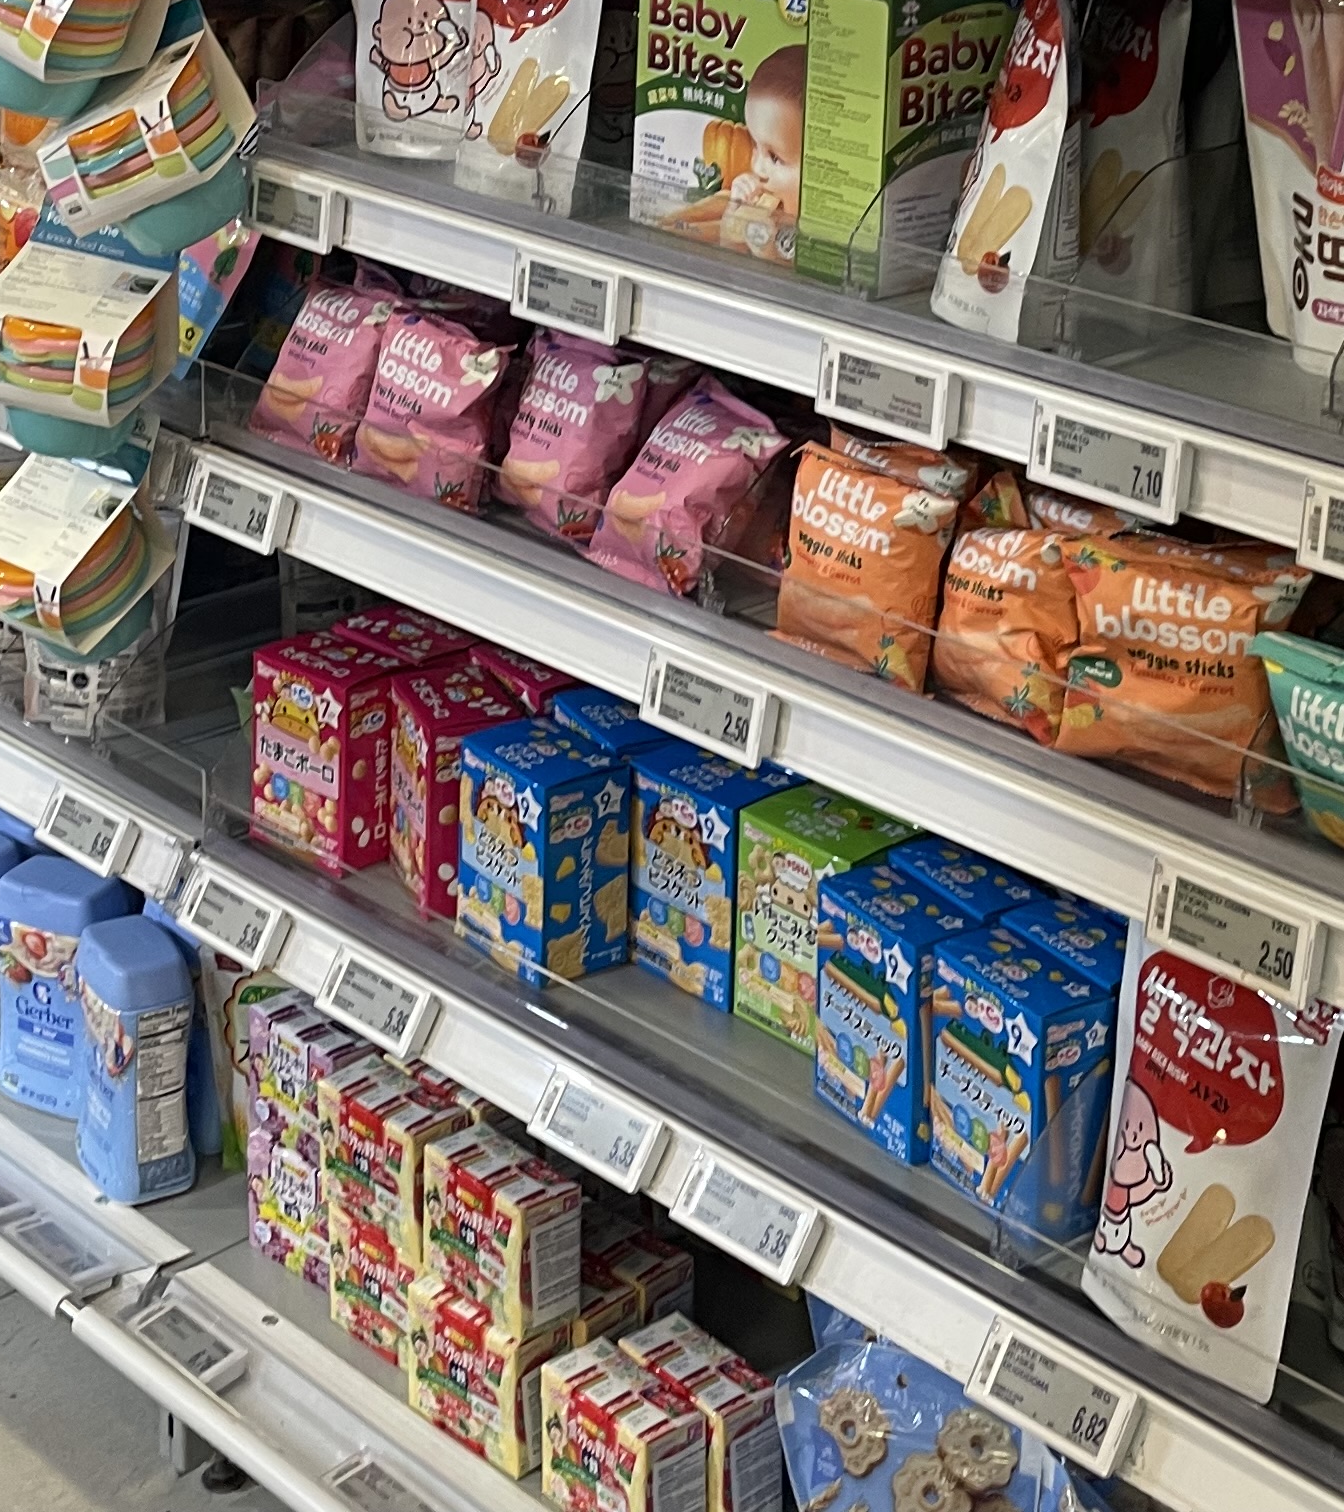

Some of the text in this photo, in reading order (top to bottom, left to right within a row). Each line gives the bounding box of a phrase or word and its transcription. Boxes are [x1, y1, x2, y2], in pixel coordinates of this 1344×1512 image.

[646, 34, 745, 90] Bites
[900, 31, 1004, 84] Baby
[898, 82, 985, 130] Bite
[311, 288, 359, 324] little
[389, 328, 444, 374] little
[817, 467, 888, 524] little
[1129, 463, 1164, 500] 7.10
[792, 488, 893, 558] blossom
[1130, 575, 1233, 624] little
[1095, 604, 1257, 659] blossom
[1126, 647, 1236, 680] veggie sticks
[319, 699, 332, 721] 7
[722, 711, 751, 745] 2.50
[258, 733, 336, 786] たまごボーロ
[519, 788, 533, 818] 9
[703, 818, 717, 840] 9
[888, 952, 902, 978] 9
[1256, 940, 1296, 980] 2.50
[15, 994, 75, 1030] Gerber
[1137, 964, 1278, 1098] 쌀떡과자
[1010, 1022, 1025, 1050] 9
[608, 1135, 635, 1169] 5.35
[759, 1227, 790, 1261] 5.35
[1071, 1405, 1111, 1451] 6.82
